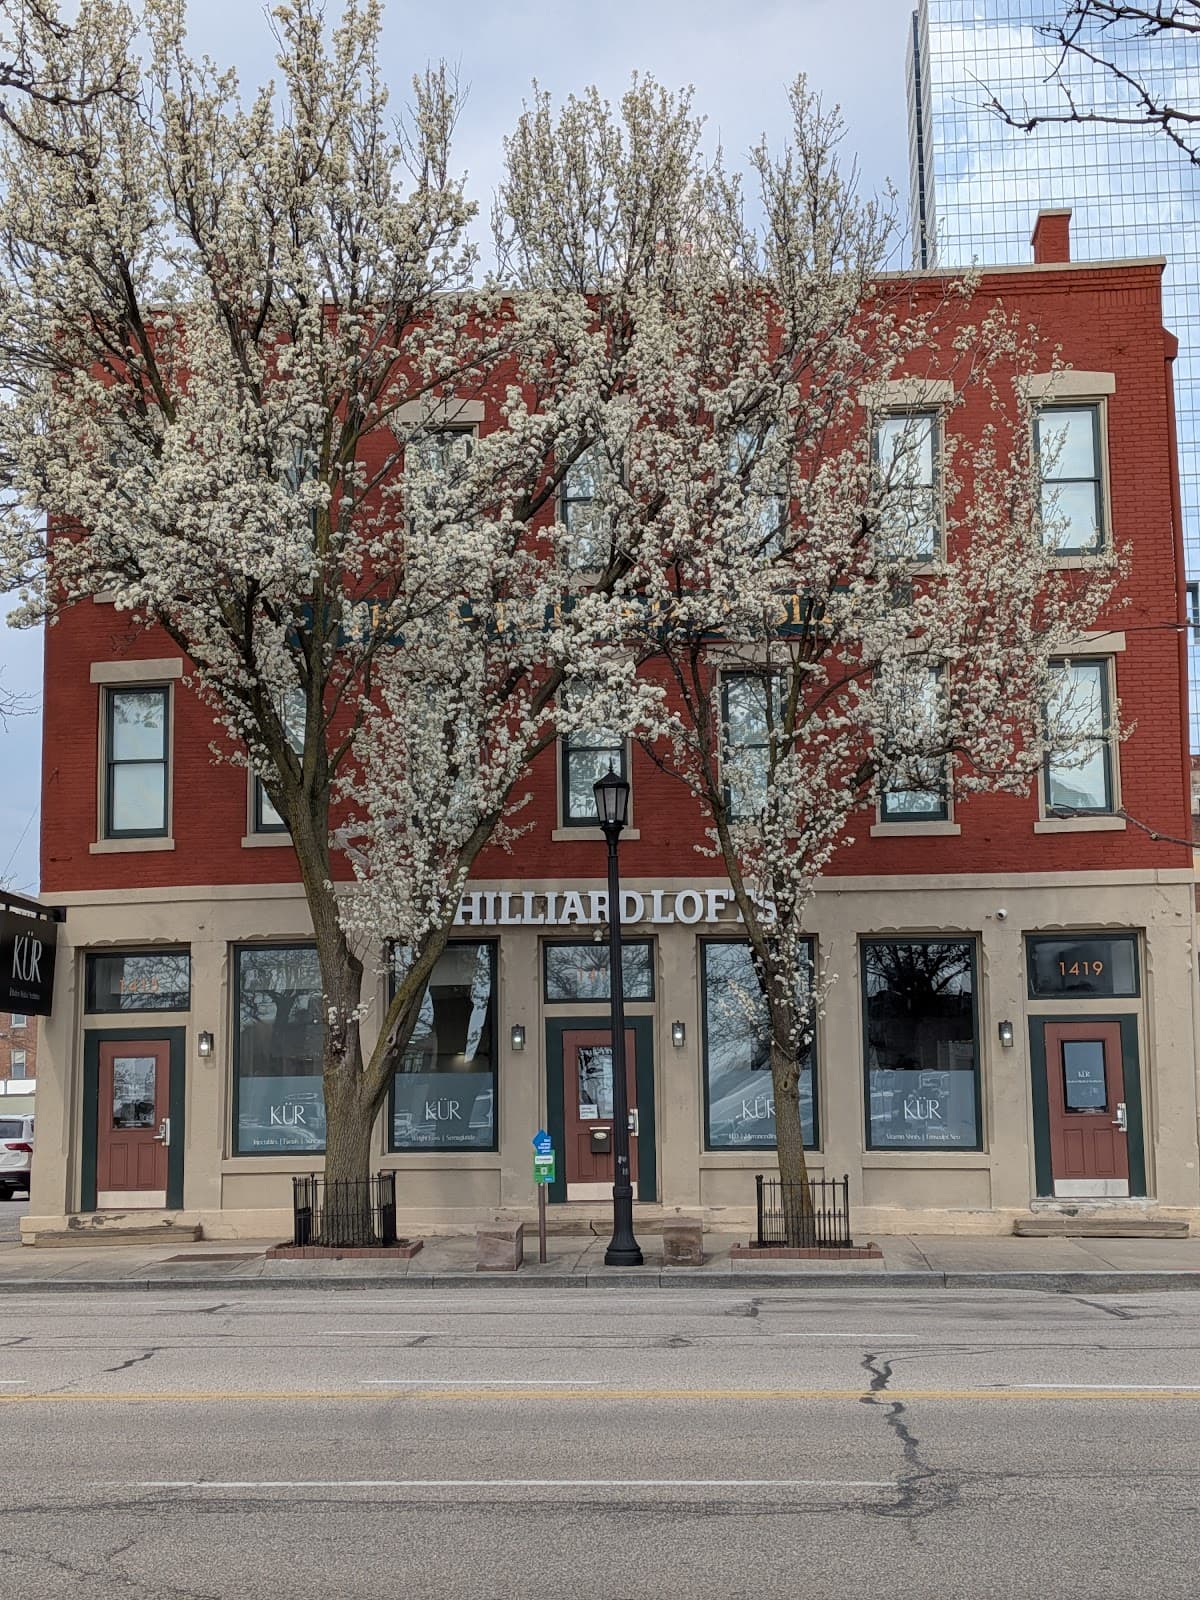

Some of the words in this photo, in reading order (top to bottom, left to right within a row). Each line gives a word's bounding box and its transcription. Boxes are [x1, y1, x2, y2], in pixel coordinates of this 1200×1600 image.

[452, 889, 645, 925] HILLIARD
[12, 930, 42, 984] KÜR
[1059, 960, 1103, 976] 1419
[270, 1102, 307, 1125] KÜR
[425, 1097, 462, 1121] KÜR
[903, 1096, 942, 1120] KÜR
